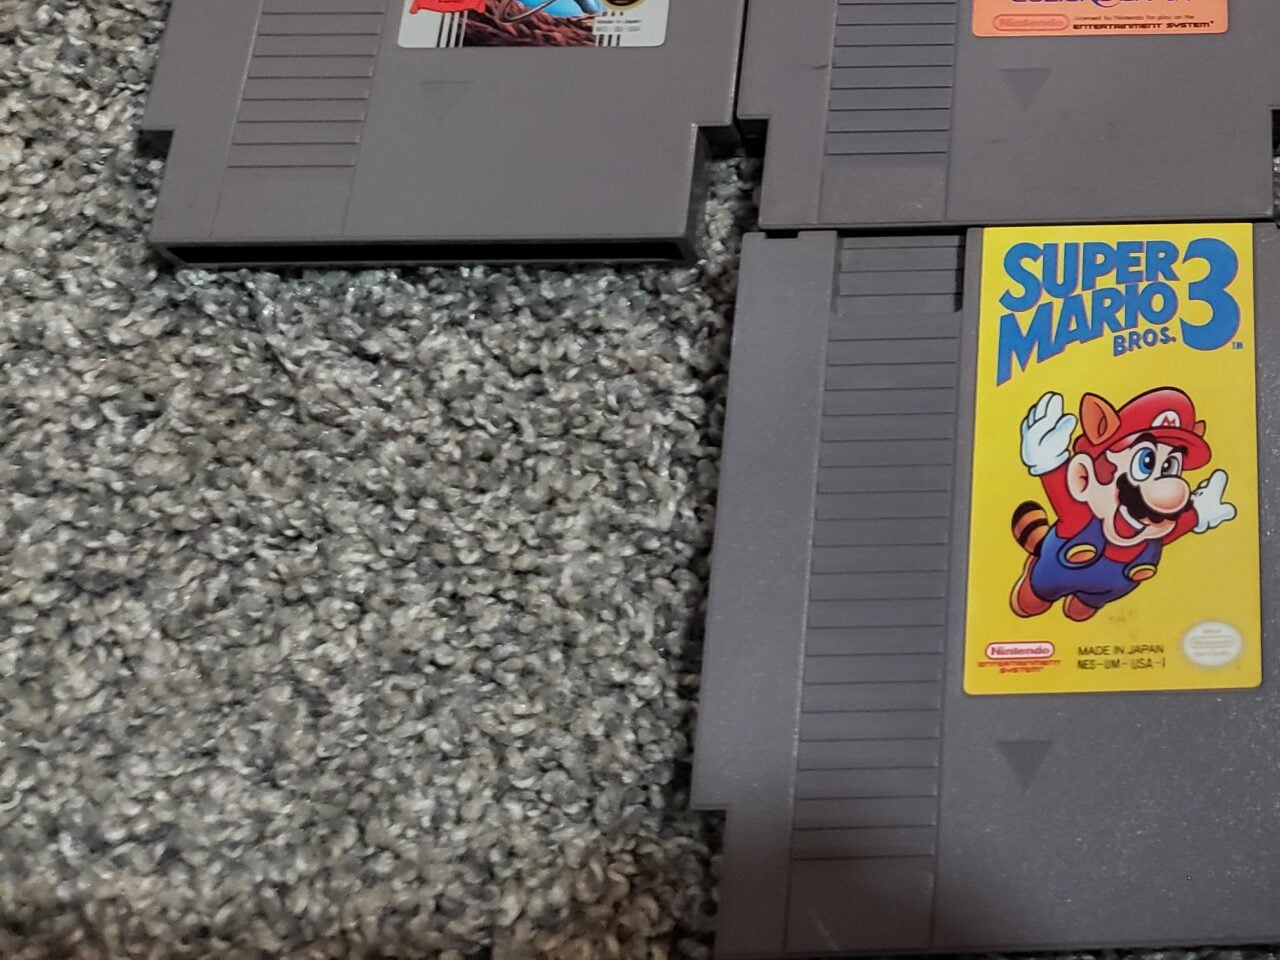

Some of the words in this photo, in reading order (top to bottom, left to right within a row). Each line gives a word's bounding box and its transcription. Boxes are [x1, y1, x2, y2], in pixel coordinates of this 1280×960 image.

[1072, 21, 1162, 30] ENTERTAINMENT
[998, 240, 1180, 313] SUPER
[1179, 237, 1241, 351] 3
[996, 281, 1179, 387] MARIO
[1112, 327, 1177, 357] BROS.
[990, 645, 1051, 656] Nintendo
[1078, 645, 1111, 656] MADE
[1113, 645, 1125, 655] IN
[1127, 644, 1165, 655] JAPAN
